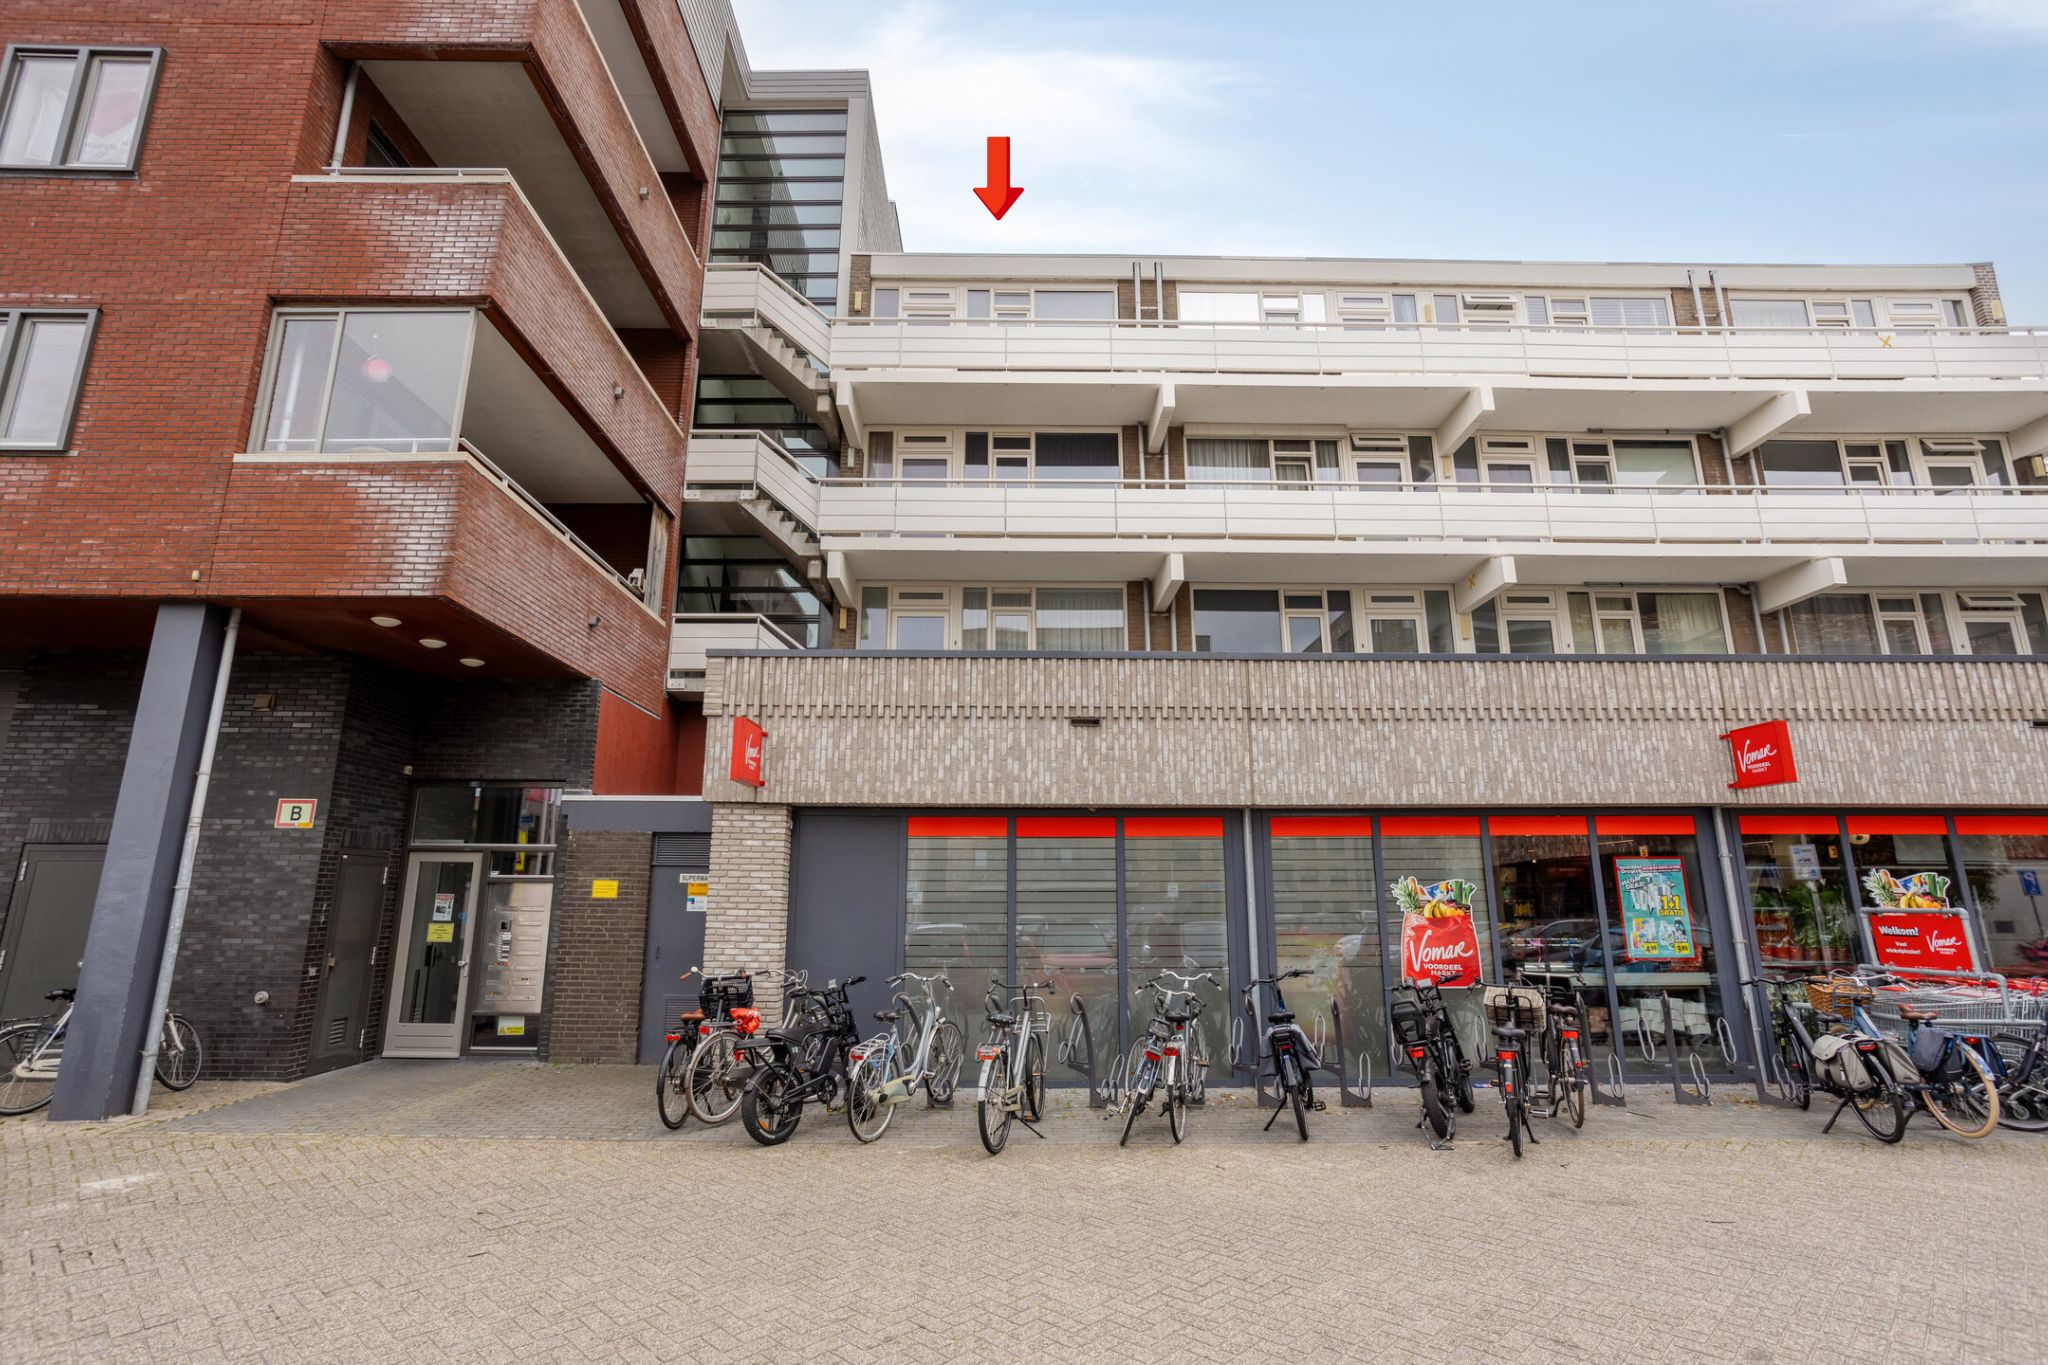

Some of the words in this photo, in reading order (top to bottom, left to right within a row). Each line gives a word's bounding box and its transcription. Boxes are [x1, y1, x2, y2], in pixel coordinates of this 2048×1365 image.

[1737, 739, 1777, 773] Vomar
[290, 806, 302, 821] B
[1661, 895, 1680, 910] 1+1
[1659, 909, 1685, 917] GRATIS
[1878, 926, 1919, 936] Welkom!
[1926, 930, 1962, 952] Vomar
[1409, 929, 1474, 972] Vomar
[1423, 963, 1463, 971] VOORDEEL
